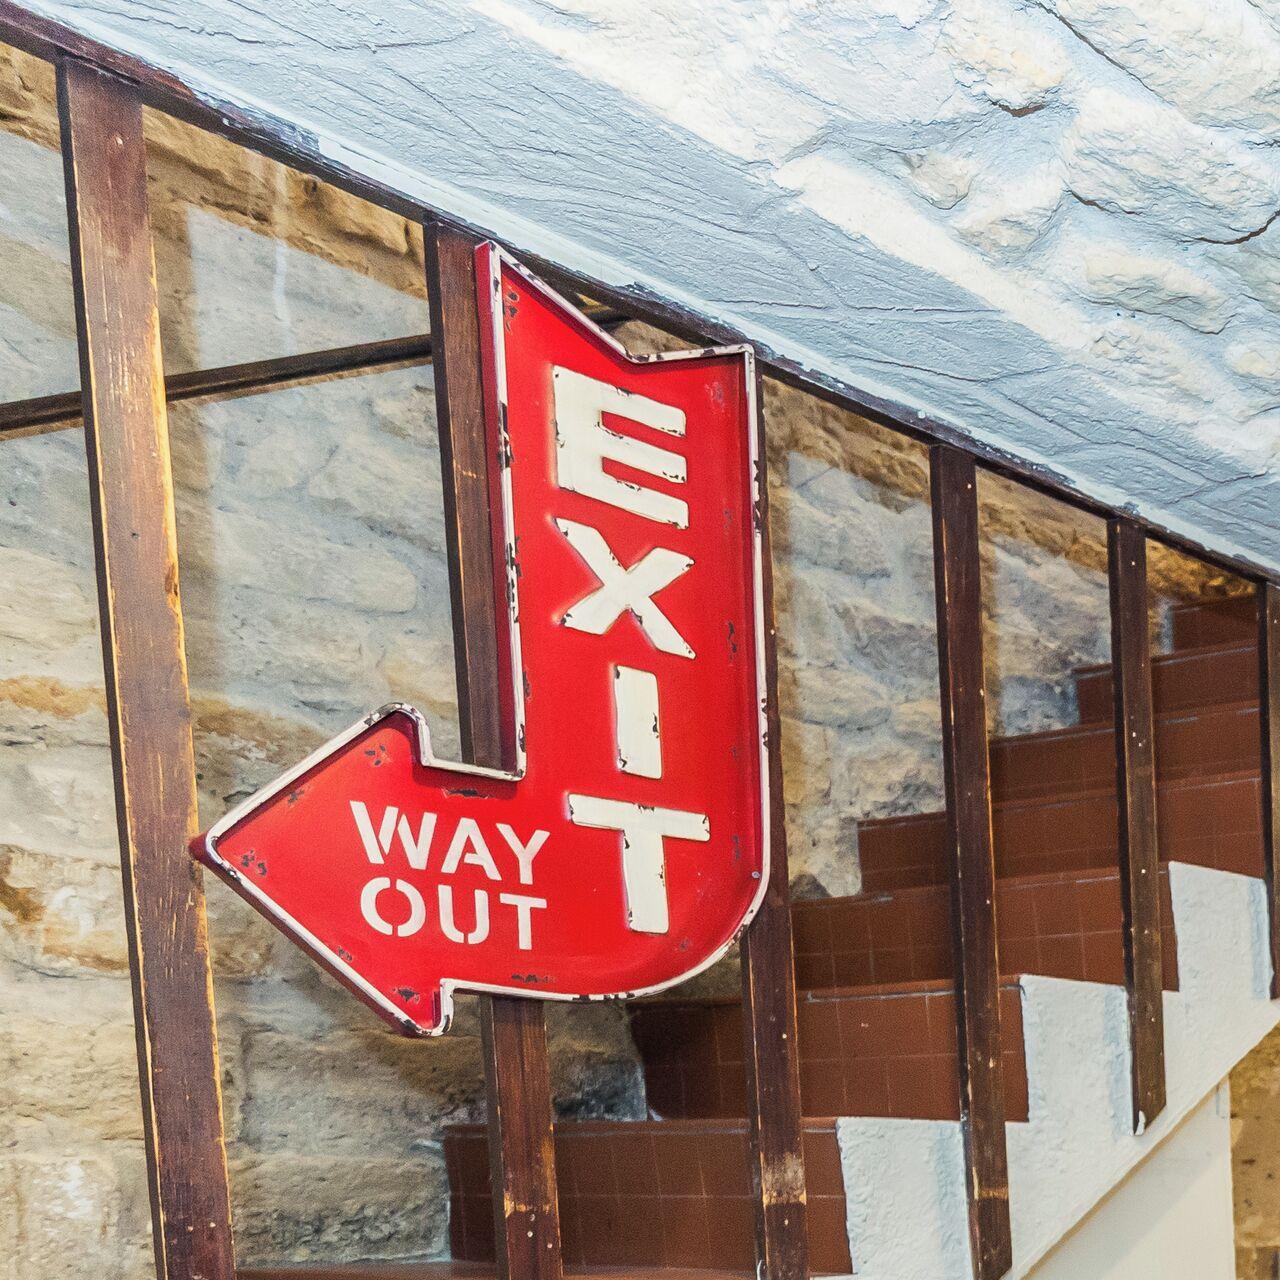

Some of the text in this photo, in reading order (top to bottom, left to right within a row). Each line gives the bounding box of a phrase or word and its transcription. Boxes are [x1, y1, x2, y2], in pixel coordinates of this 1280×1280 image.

[553, 363, 711, 935] EXIT
[349, 800, 551, 885] WAY
[359, 877, 548, 951] OUT
